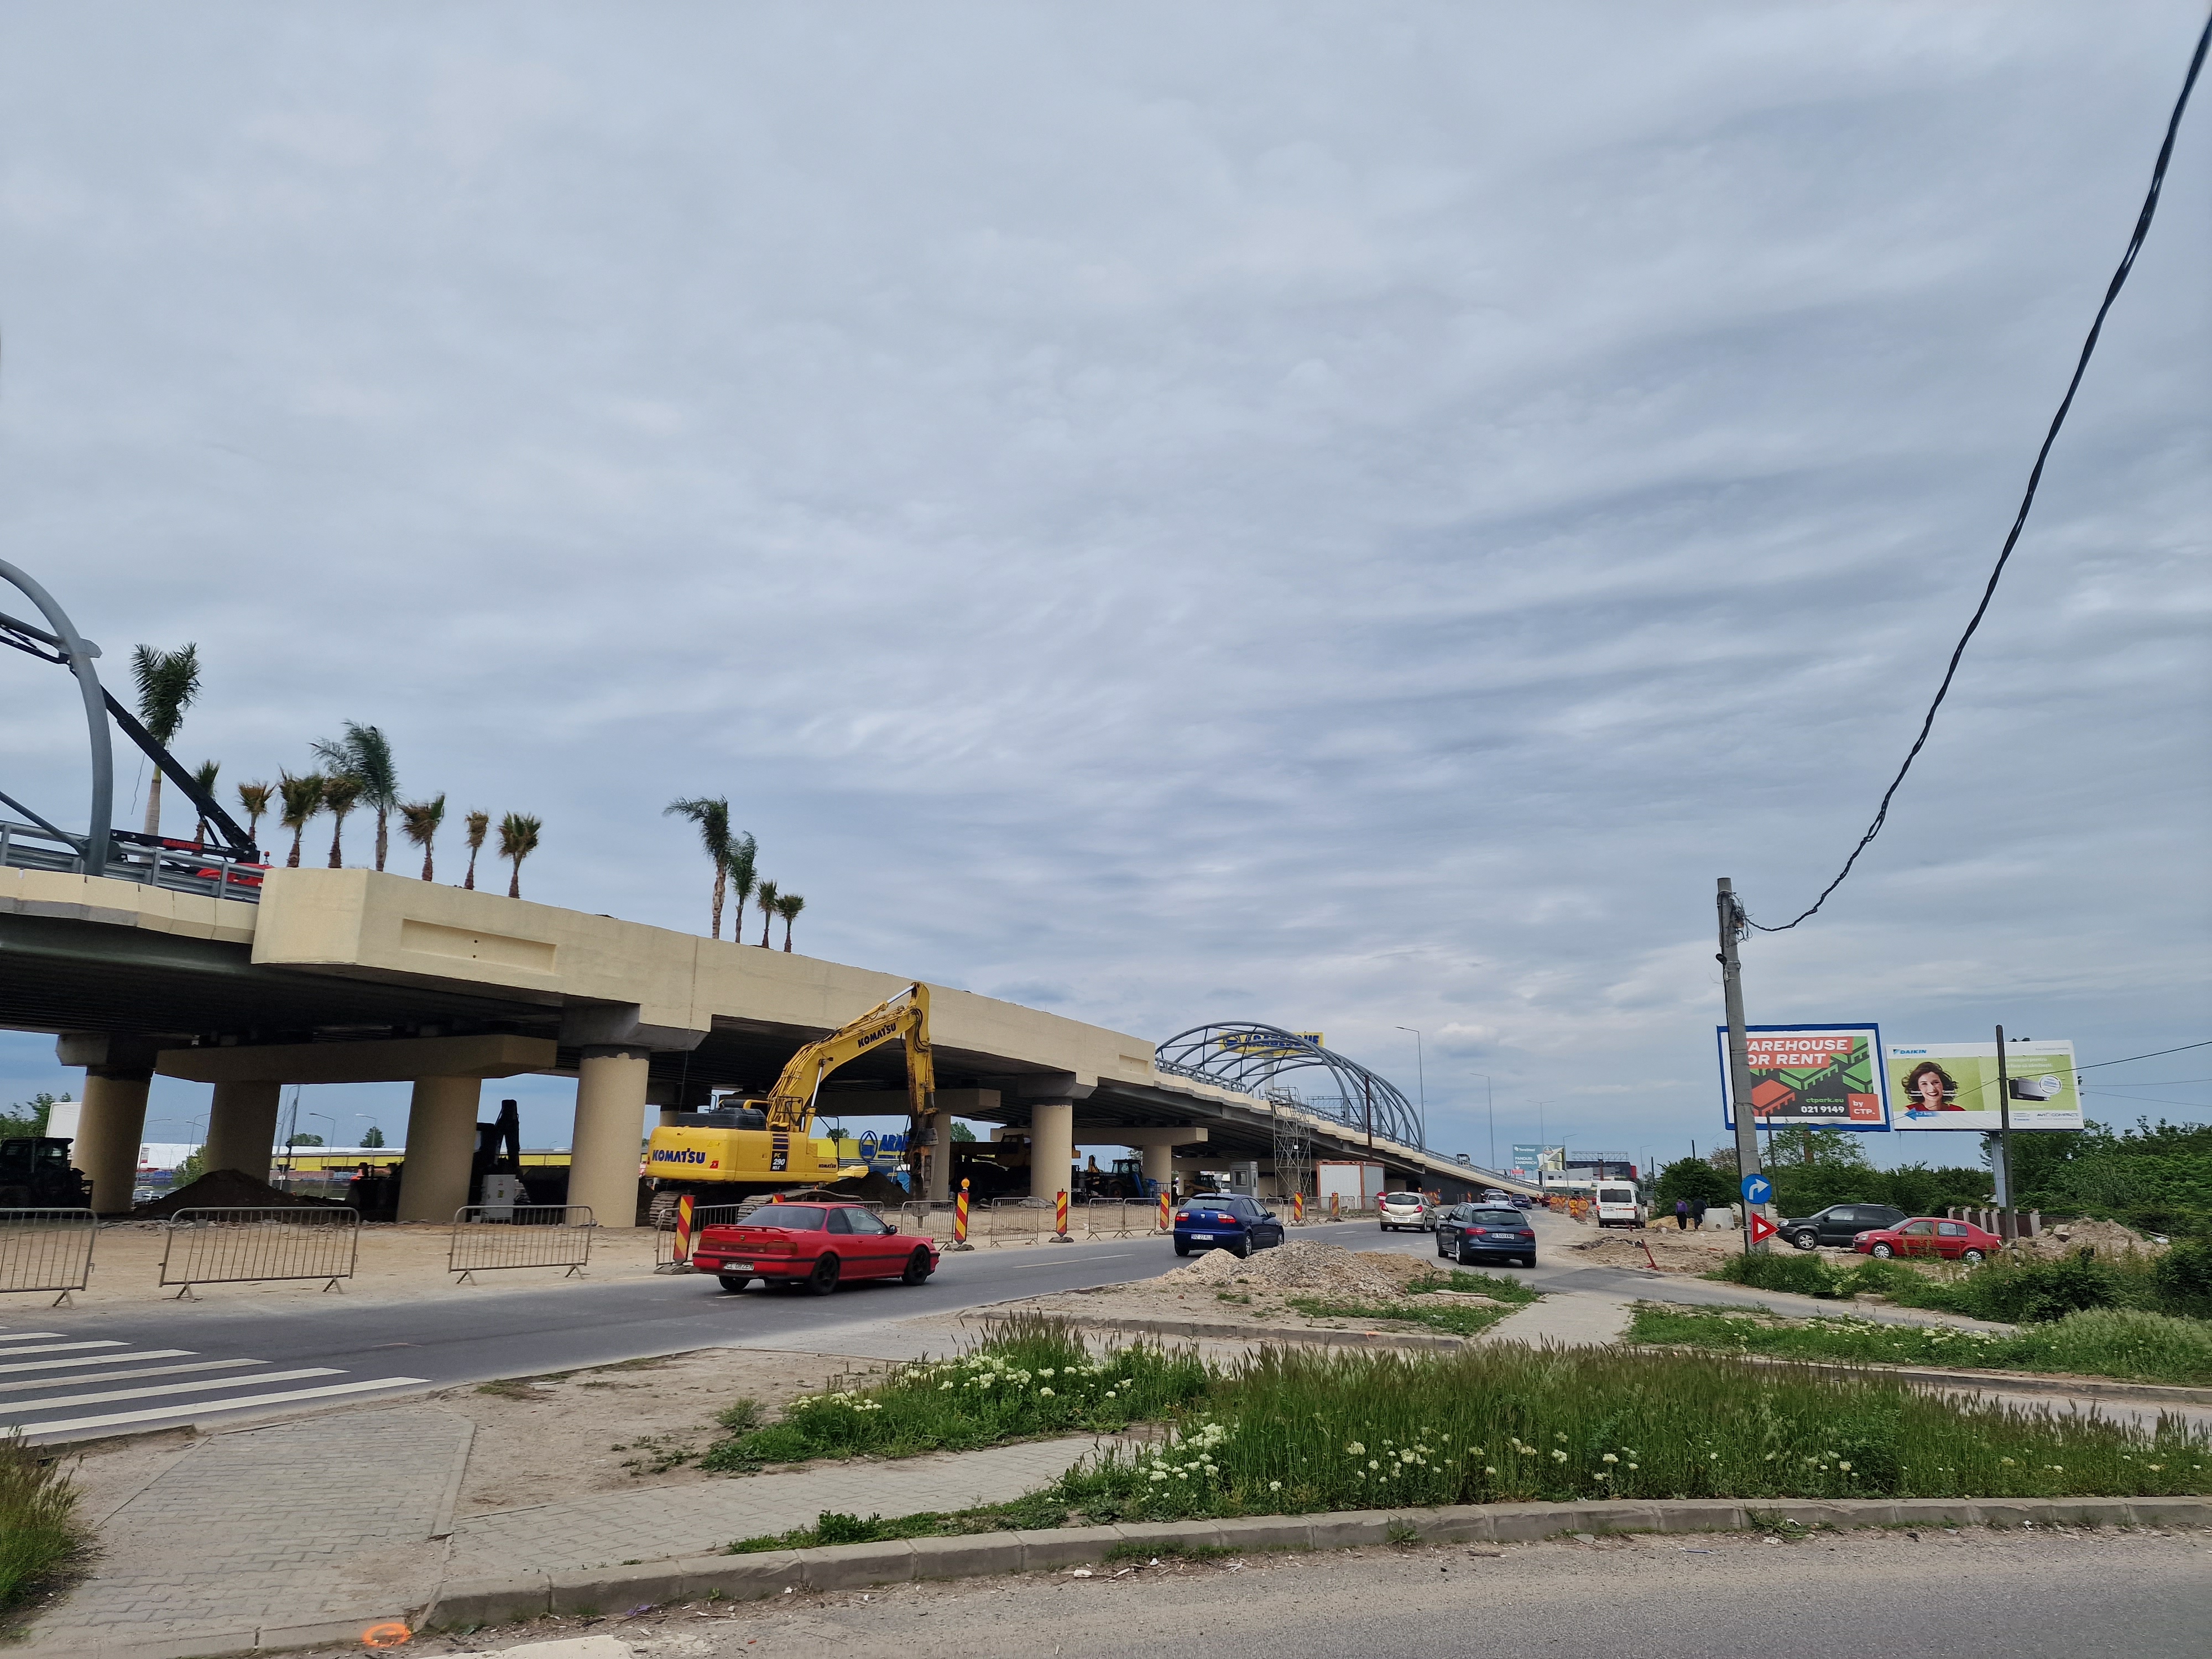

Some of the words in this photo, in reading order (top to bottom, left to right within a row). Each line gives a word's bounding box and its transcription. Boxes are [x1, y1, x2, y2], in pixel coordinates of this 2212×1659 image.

[858, 1022, 896, 1048] KOMATSU
[1747, 1039, 1848, 1051] AREHOUSE
[1748, 1053, 1770, 1065] OR
[1776, 1053, 1826, 1065] RENT
[652, 1148, 706, 1164] KOMATSU
